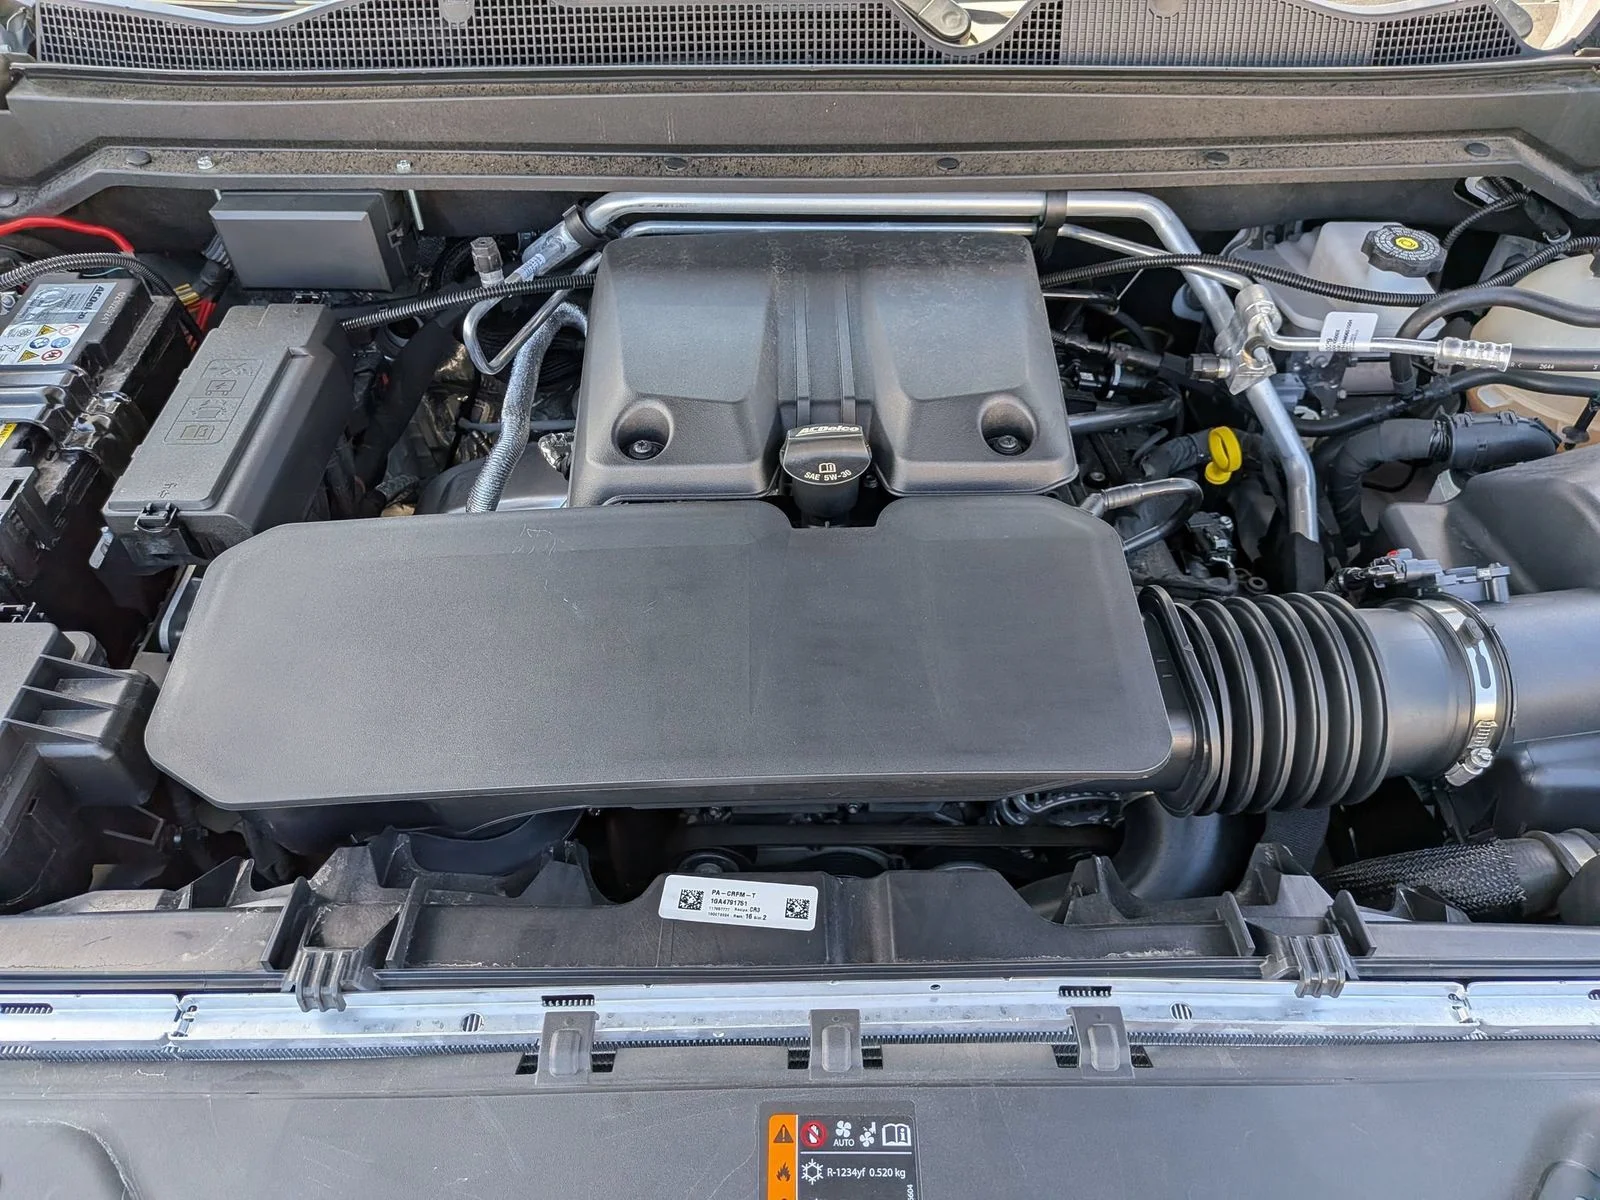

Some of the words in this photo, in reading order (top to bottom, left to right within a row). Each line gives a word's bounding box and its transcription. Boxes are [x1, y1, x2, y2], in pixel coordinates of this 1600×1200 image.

[78, 286, 104, 320] ACDelco
[797, 425, 859, 436] ACDelco
[804, 471, 821, 480] SAE
[824, 469, 852, 481] 5W-30
[833, 1138, 855, 1147] AUTO
[827, 1167, 866, 1180] R-1234yf
[869, 1167, 893, 1177] 0.520
[894, 1167, 906, 1180] kg
